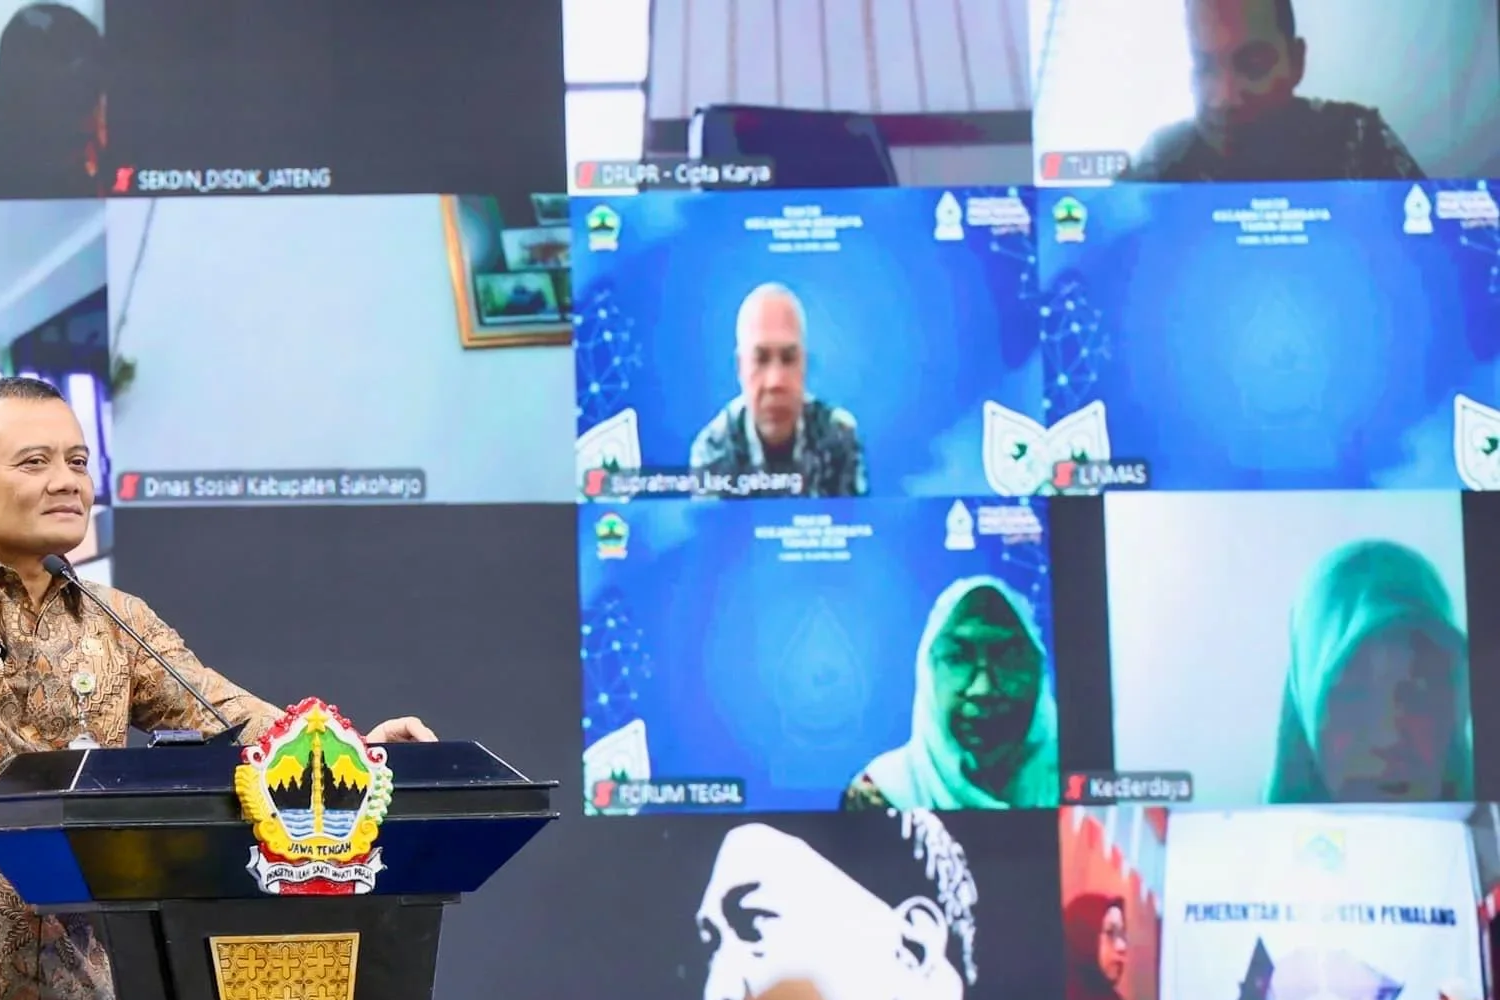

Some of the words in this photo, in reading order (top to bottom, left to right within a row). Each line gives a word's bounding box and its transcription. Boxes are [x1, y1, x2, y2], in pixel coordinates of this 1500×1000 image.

[674, 163, 719, 188] Cipta
[722, 163, 771, 186] Karya
[145, 476, 191, 497] Dinas
[194, 476, 243, 497] Sosial
[247, 475, 336, 500] Kabupaten
[339, 474, 422, 500] Sukoharjo
[619, 783, 686, 804] FORUM
[688, 783, 743, 803] TEGAL
[288, 843, 313, 855] JAWA
[316, 842, 351, 856] TENGAH
[1380, 904, 1457, 926] PEMALANG
